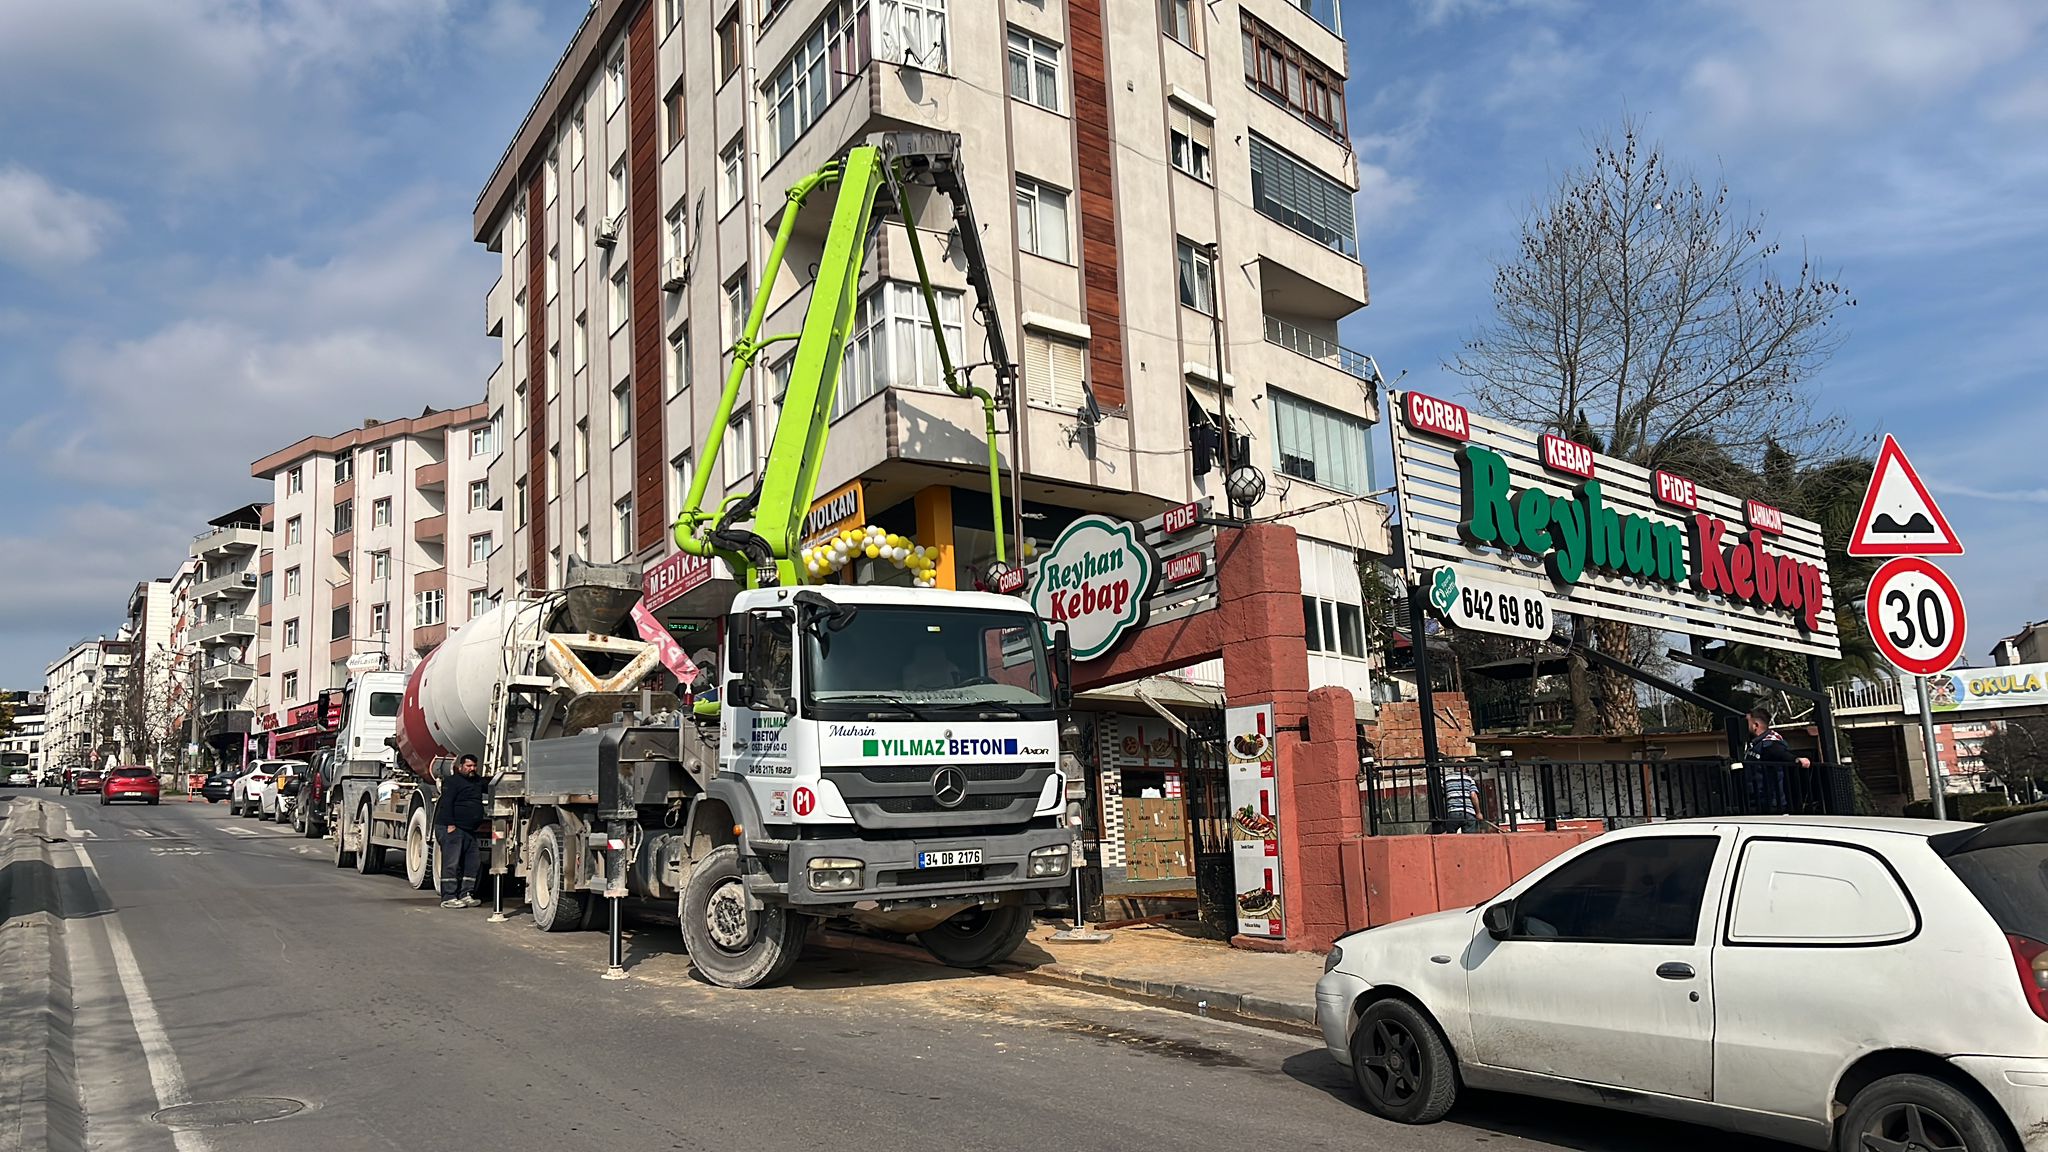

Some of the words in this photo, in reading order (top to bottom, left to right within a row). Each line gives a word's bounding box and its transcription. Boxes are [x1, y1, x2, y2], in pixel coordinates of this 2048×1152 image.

[1412, 397, 1466, 435] ÇORBA
[1544, 438, 1593, 476] KEBAP
[809, 489, 856, 534] VOLKAN
[1749, 502, 1781, 531] LAHMACUN
[1459, 445, 1687, 584] Reyhan
[1694, 512, 1823, 633] Kebap
[650, 553, 708, 596] MEDİKAL
[1047, 547, 1124, 593] Reyhan
[1167, 554, 1200, 581] LAHMACUN
[1050, 578, 1129, 625] Kebap
[1462, 586, 1495, 622] 642
[1498, 593, 1520, 626] 69
[1523, 598, 1544, 630] 88
[1884, 588, 1946, 650] 30
[1968, 673, 2042, 697] OKULA
[756, 730, 780, 742] BETON
[763, 716, 788, 729] YILMAZ
[828, 724, 877, 738] Muhsin
[881, 739, 946, 757] YILMAZ
[949, 738, 1003, 756] BETON
[796, 790, 811, 813] P1
[926, 853, 938, 866] 34
[941, 852, 954, 865] DB
[957, 850, 980, 864] 2176
